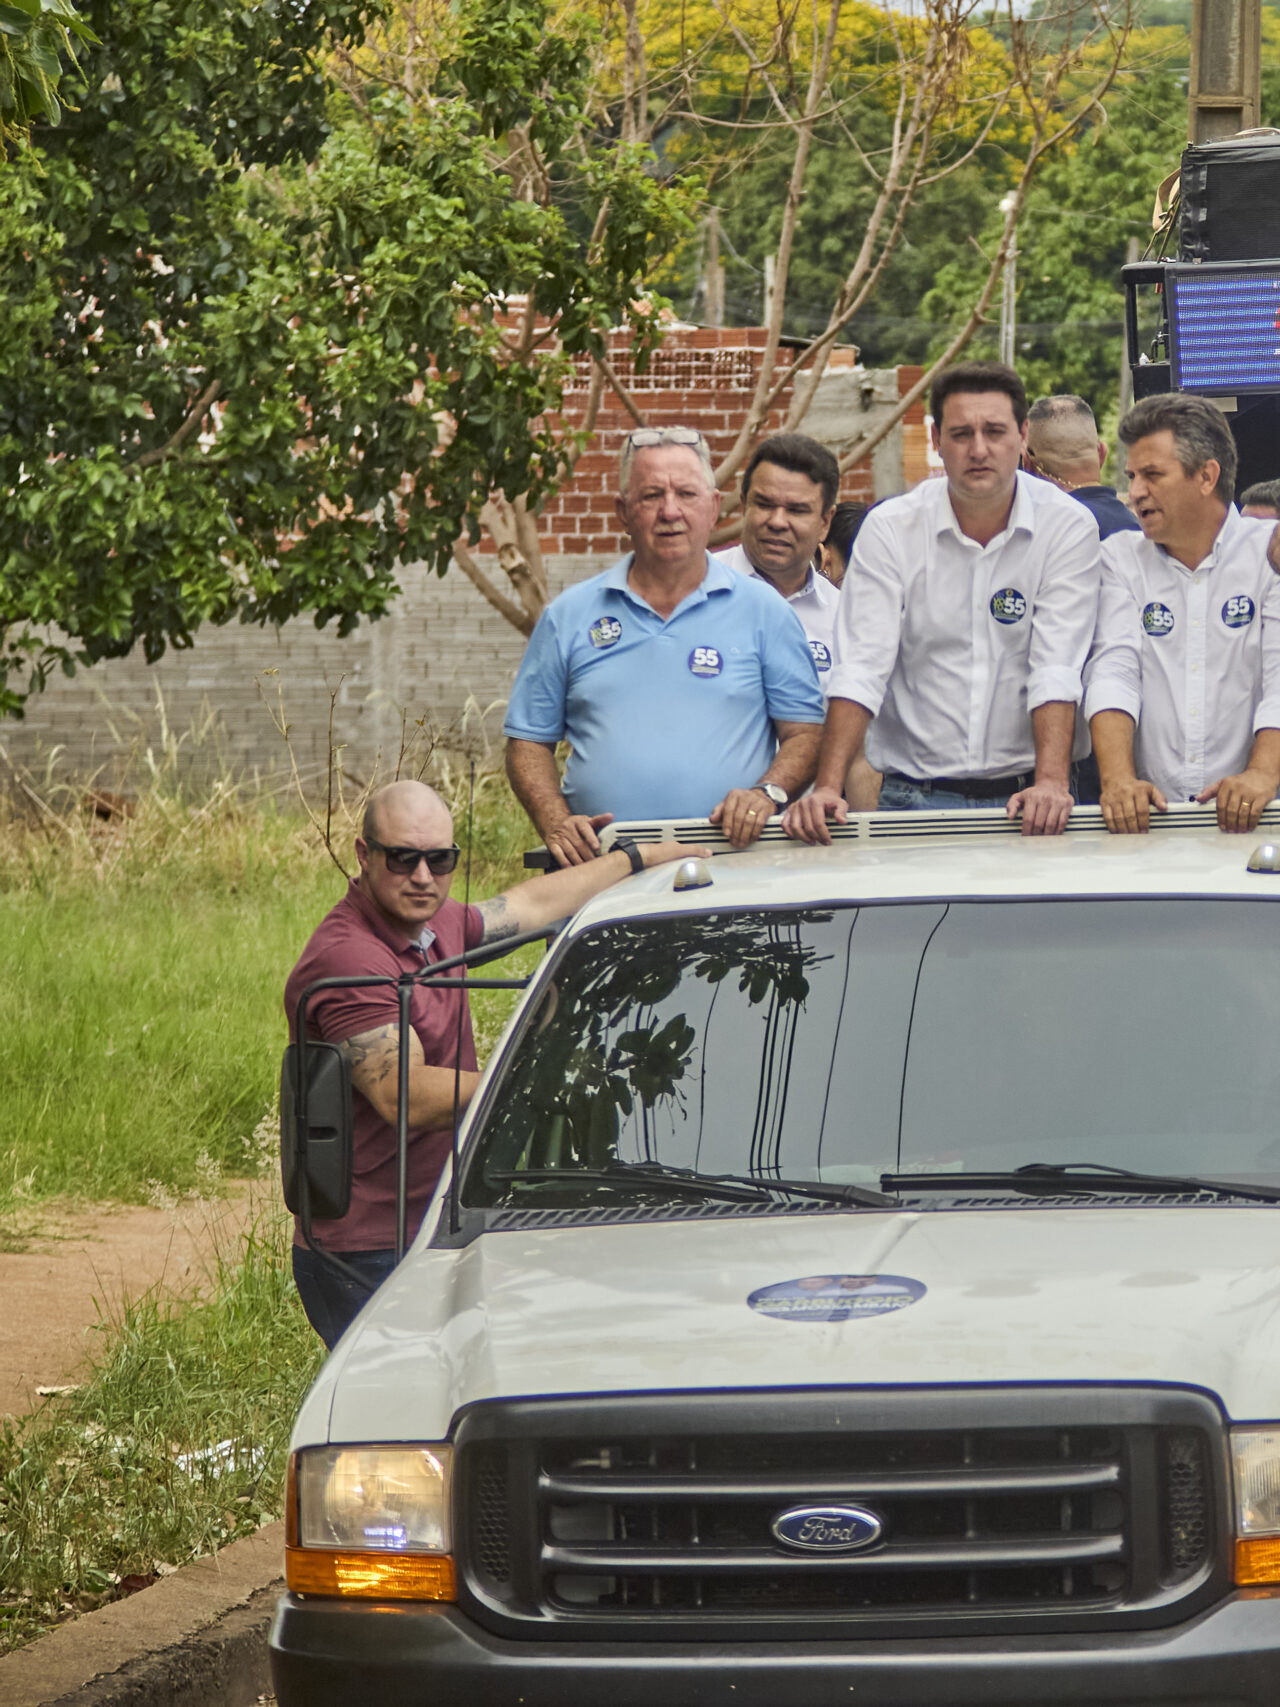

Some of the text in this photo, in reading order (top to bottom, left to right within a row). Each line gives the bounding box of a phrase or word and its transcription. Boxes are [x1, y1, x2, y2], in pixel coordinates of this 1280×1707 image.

[1004, 597, 1025, 615] 55
[1228, 596, 1250, 616] 55
[1153, 610, 1173, 627] 55
[601, 622, 622, 640] 55
[693, 647, 719, 666] 55
[798, 1516, 857, 1541] Ford
